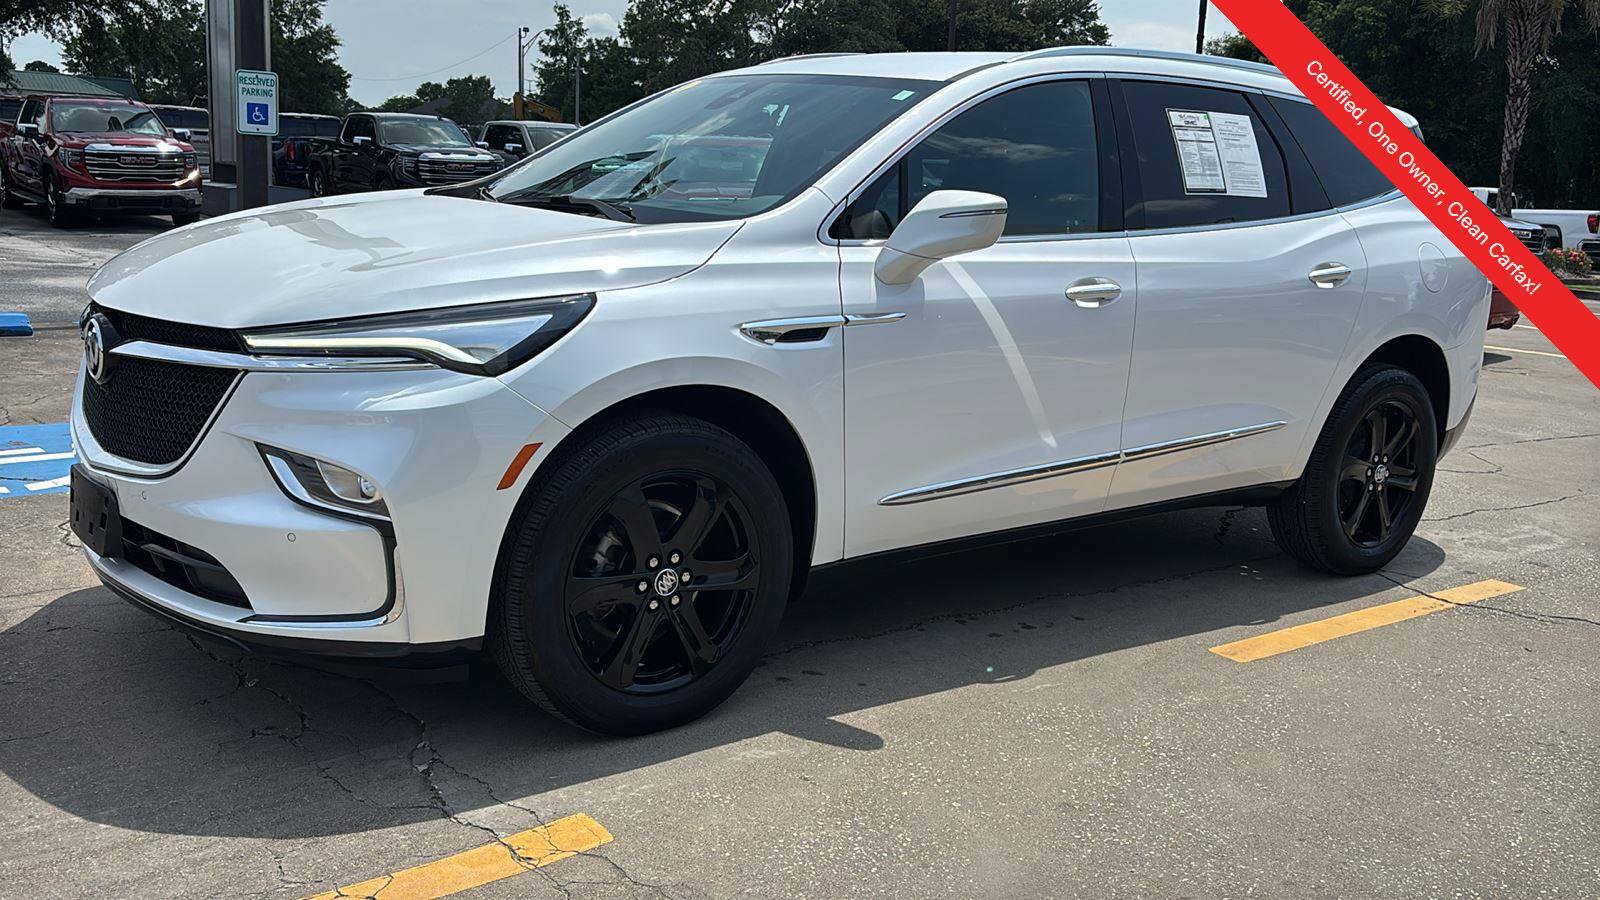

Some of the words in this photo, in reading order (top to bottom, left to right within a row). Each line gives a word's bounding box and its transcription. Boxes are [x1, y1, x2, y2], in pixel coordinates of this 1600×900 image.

[239, 76, 276, 88] RESERVED
[241, 87, 274, 98] PARKING
[120, 156, 156, 164] GMC
